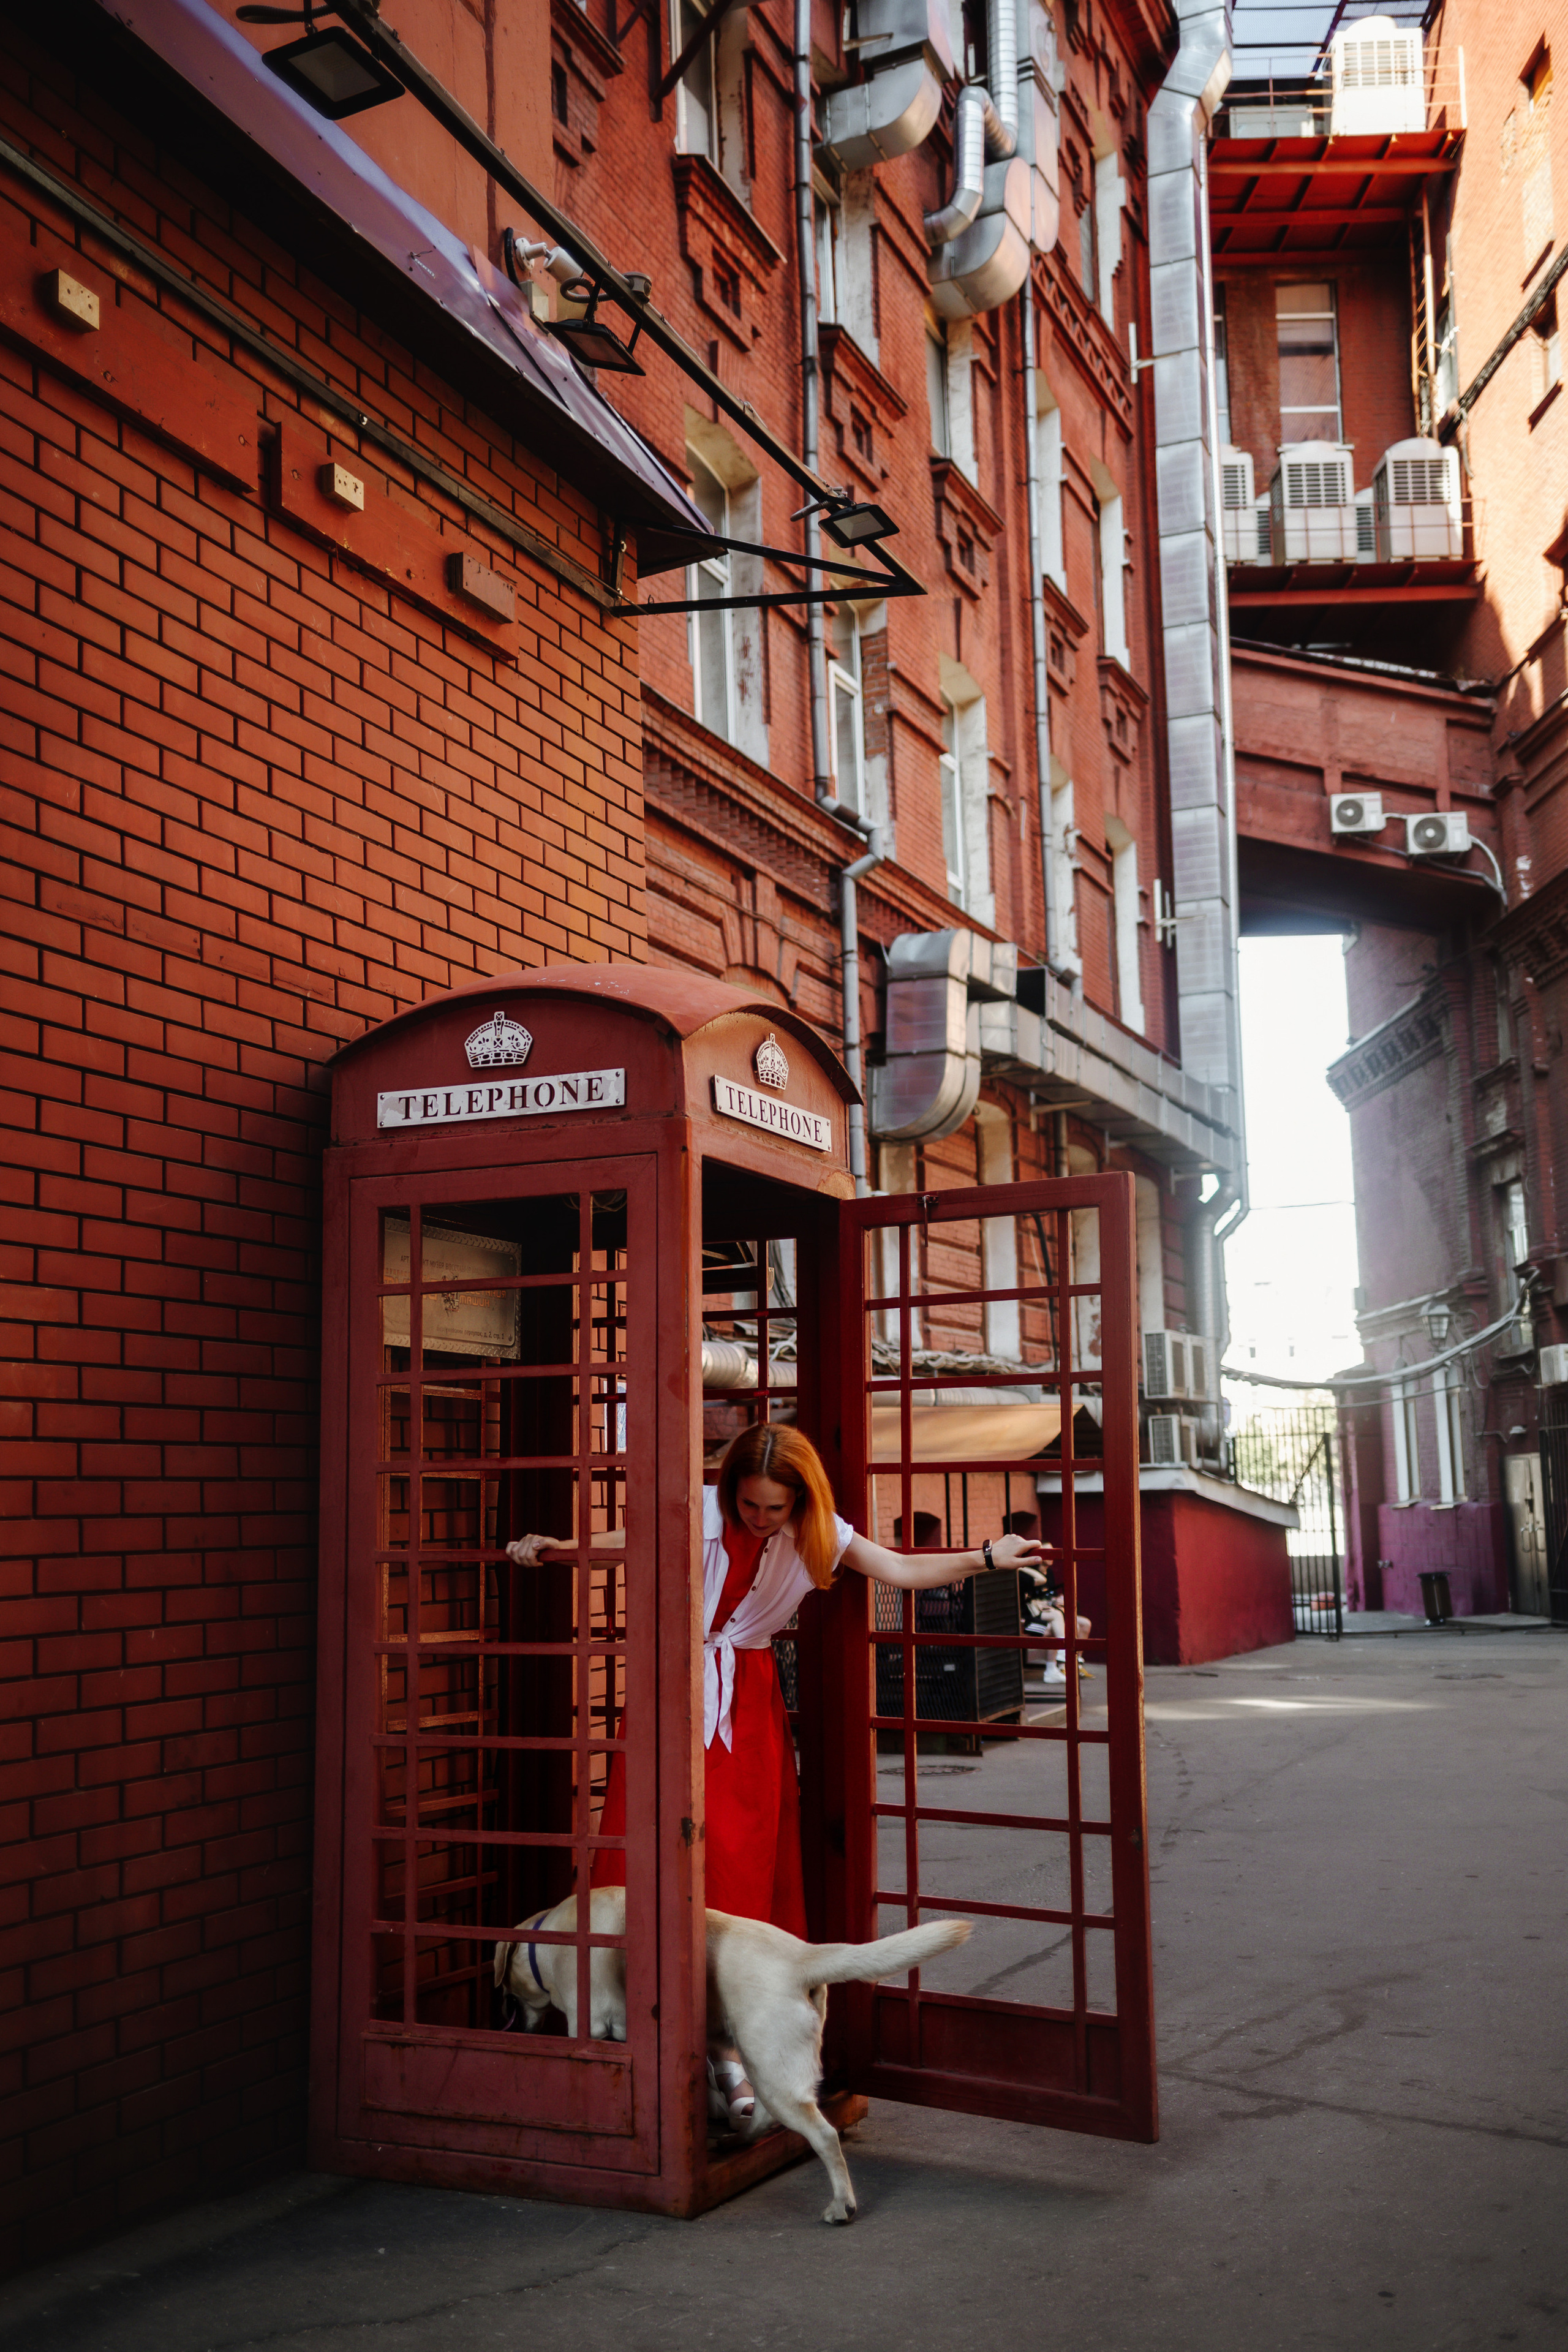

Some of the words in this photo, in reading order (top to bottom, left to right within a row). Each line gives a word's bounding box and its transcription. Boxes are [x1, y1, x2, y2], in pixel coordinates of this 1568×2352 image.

[399, 1077, 604, 1120] TELEPHONE
[725, 1085, 823, 1143] TELEPHONE
[459, 1295, 490, 1308] МАШИН
